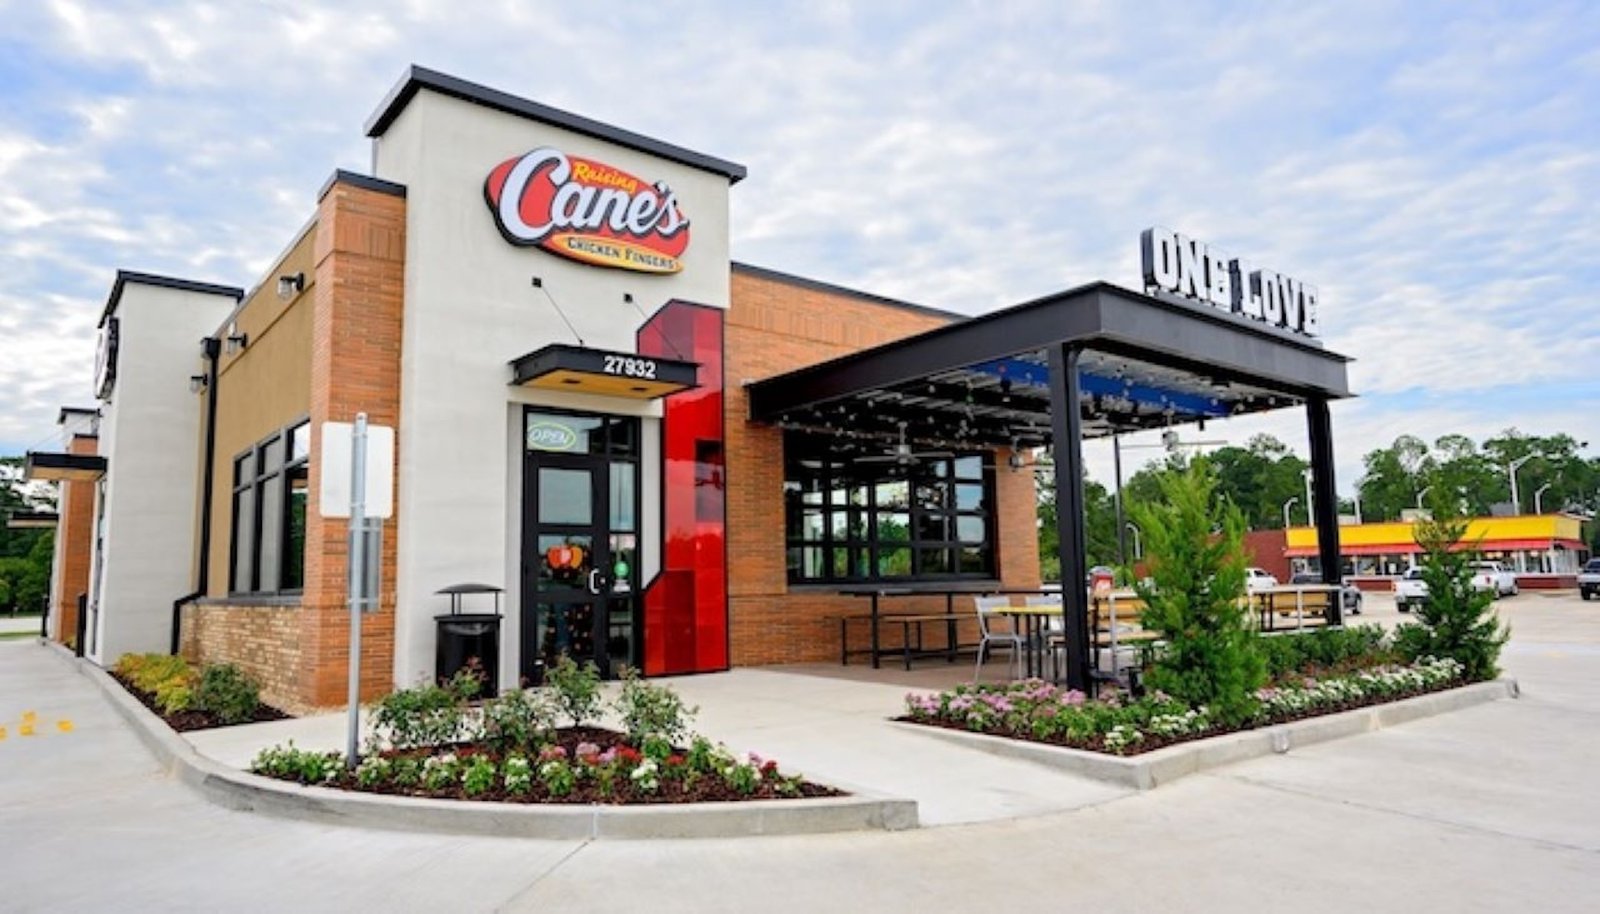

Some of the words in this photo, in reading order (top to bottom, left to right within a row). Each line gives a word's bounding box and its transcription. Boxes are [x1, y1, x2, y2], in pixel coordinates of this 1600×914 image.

[500, 146, 689, 241] Cane's
[573, 161, 637, 194] Raising
[1141, 226, 1230, 313] ONE
[1229, 257, 1320, 338] LOVE
[604, 355, 657, 380] 27932
[529, 427, 570, 447] OPEN
